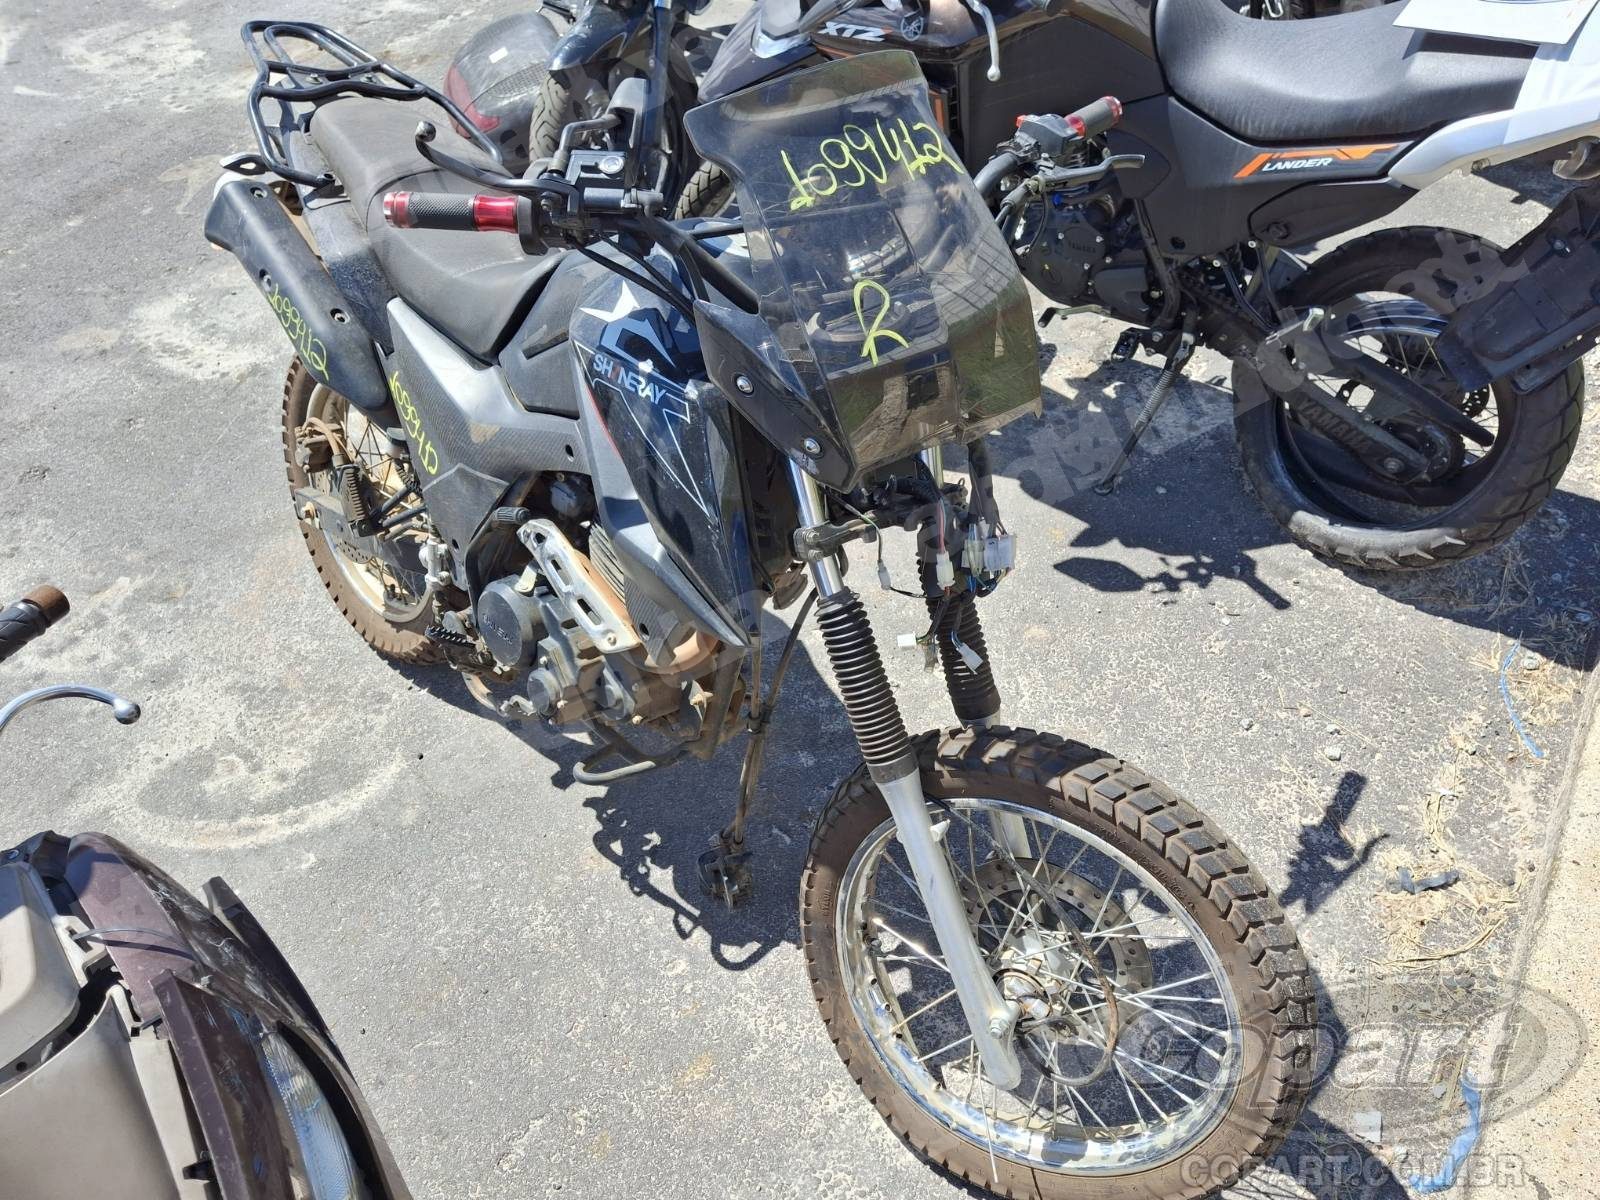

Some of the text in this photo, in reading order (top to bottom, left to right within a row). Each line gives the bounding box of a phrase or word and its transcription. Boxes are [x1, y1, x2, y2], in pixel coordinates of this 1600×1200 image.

[817, 21, 886, 42] XTZ
[781, 118, 965, 211] 1099412
[1262, 157, 1333, 172] LANDER
[593, 353, 667, 405] SHINERAY
[1298, 397, 1374, 456] YAMAHA
